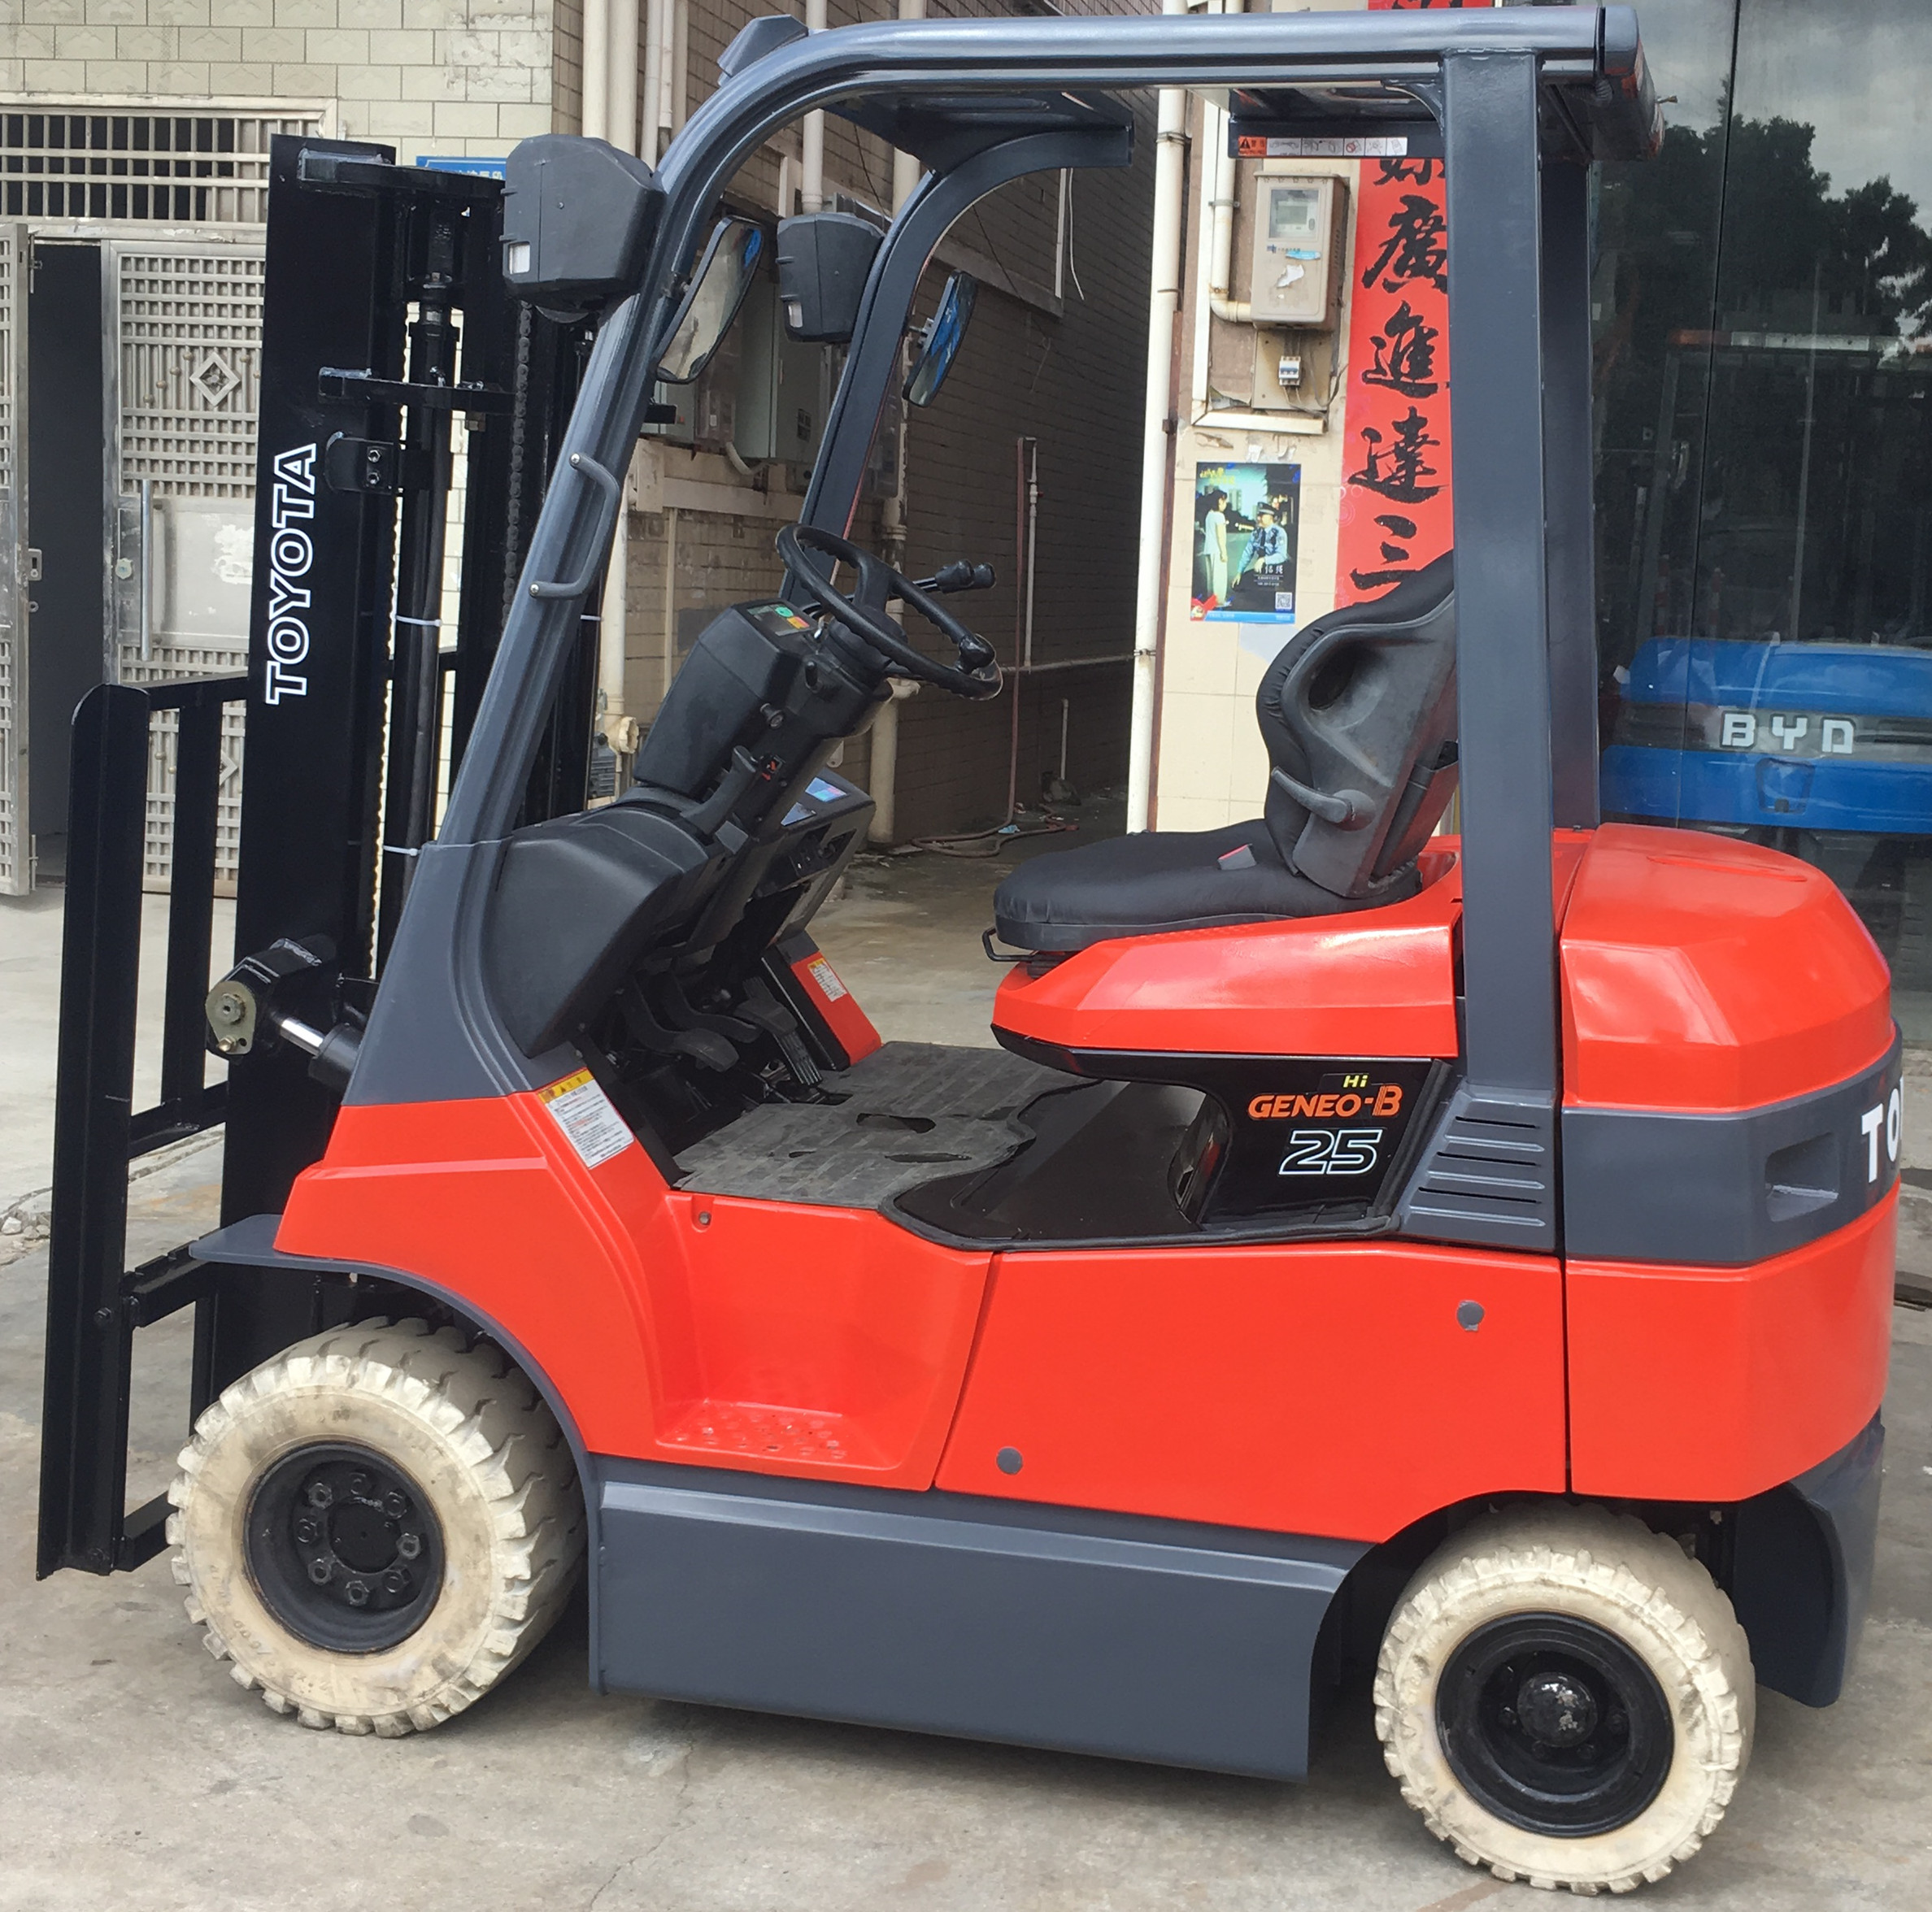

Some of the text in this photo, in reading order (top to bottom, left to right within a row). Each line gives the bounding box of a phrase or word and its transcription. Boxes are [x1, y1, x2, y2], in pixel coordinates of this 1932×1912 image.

[1348, 156, 1450, 590] 廣進達三
[265, 443, 317, 705] TOYOTA
[1721, 713, 1855, 754] BYD
[1247, 1084, 1403, 1119] GENEO-B
[1342, 1075, 1368, 1088] Hi
[1278, 1129, 1383, 1175] 25
[1861, 1075, 1904, 1184] TO
